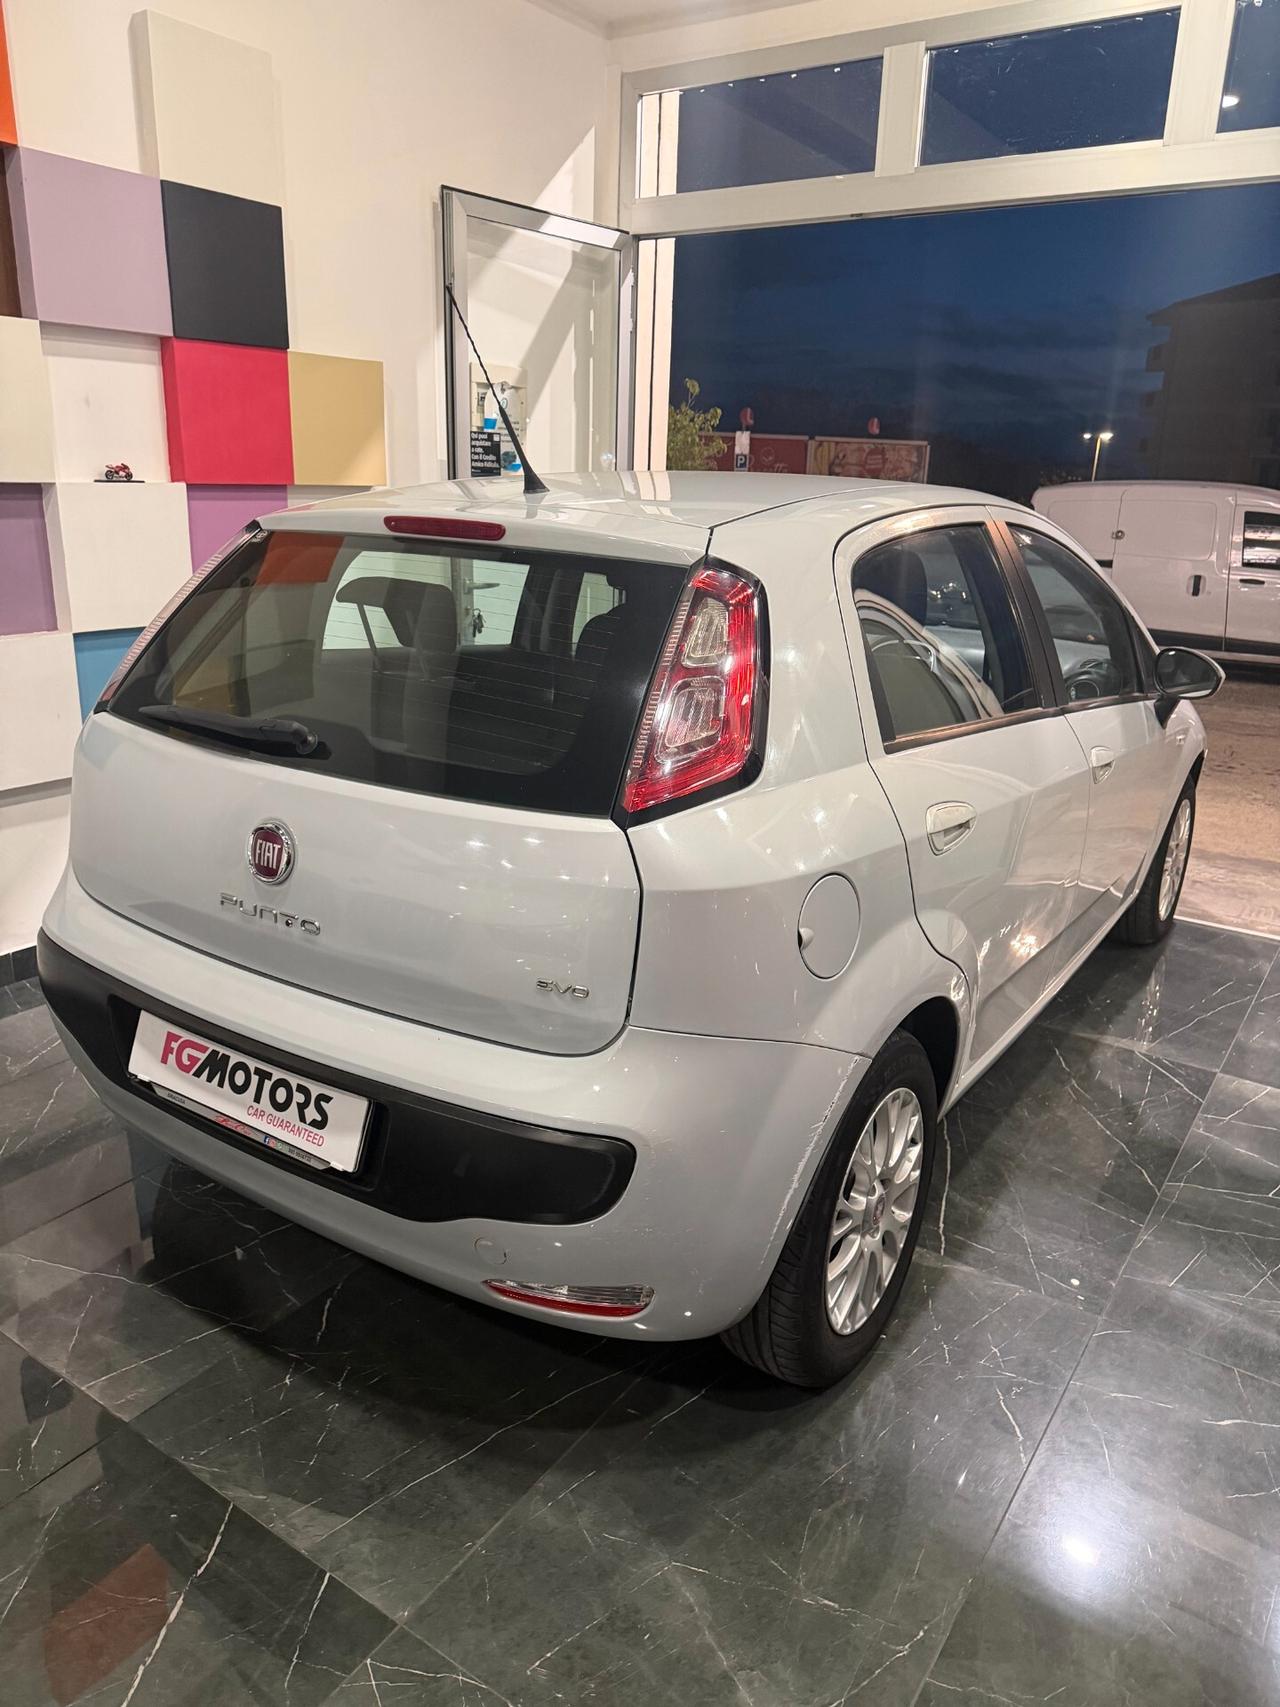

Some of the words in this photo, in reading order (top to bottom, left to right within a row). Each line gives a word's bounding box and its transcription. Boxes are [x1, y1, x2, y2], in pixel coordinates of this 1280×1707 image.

[738, 455, 745, 467] P
[255, 839, 282, 870] FIAT
[220, 892, 321, 936] PUNTO
[536, 977, 590, 999] EVO
[246, 1105, 266, 1123] CAR
[265, 1112, 325, 1148] GUARANTEED
